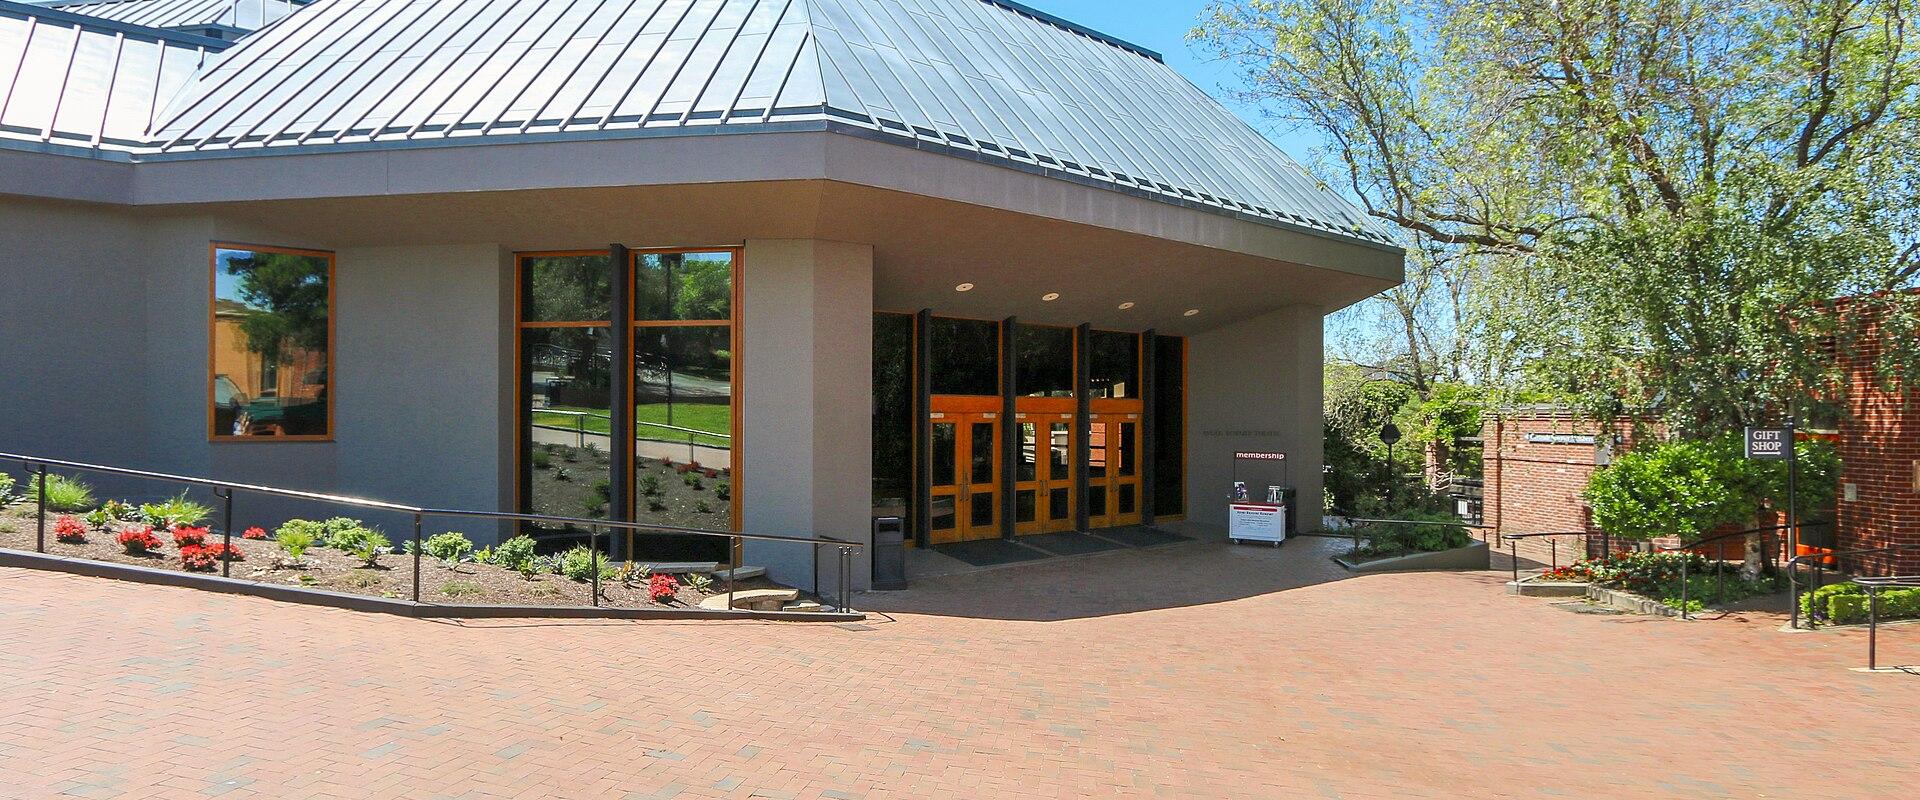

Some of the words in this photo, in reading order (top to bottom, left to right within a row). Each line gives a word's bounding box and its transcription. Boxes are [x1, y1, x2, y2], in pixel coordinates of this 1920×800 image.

[1752, 430, 1781, 440] GIFT
[1751, 441, 1782, 451] SHOP
[1236, 452, 1285, 460] membership
